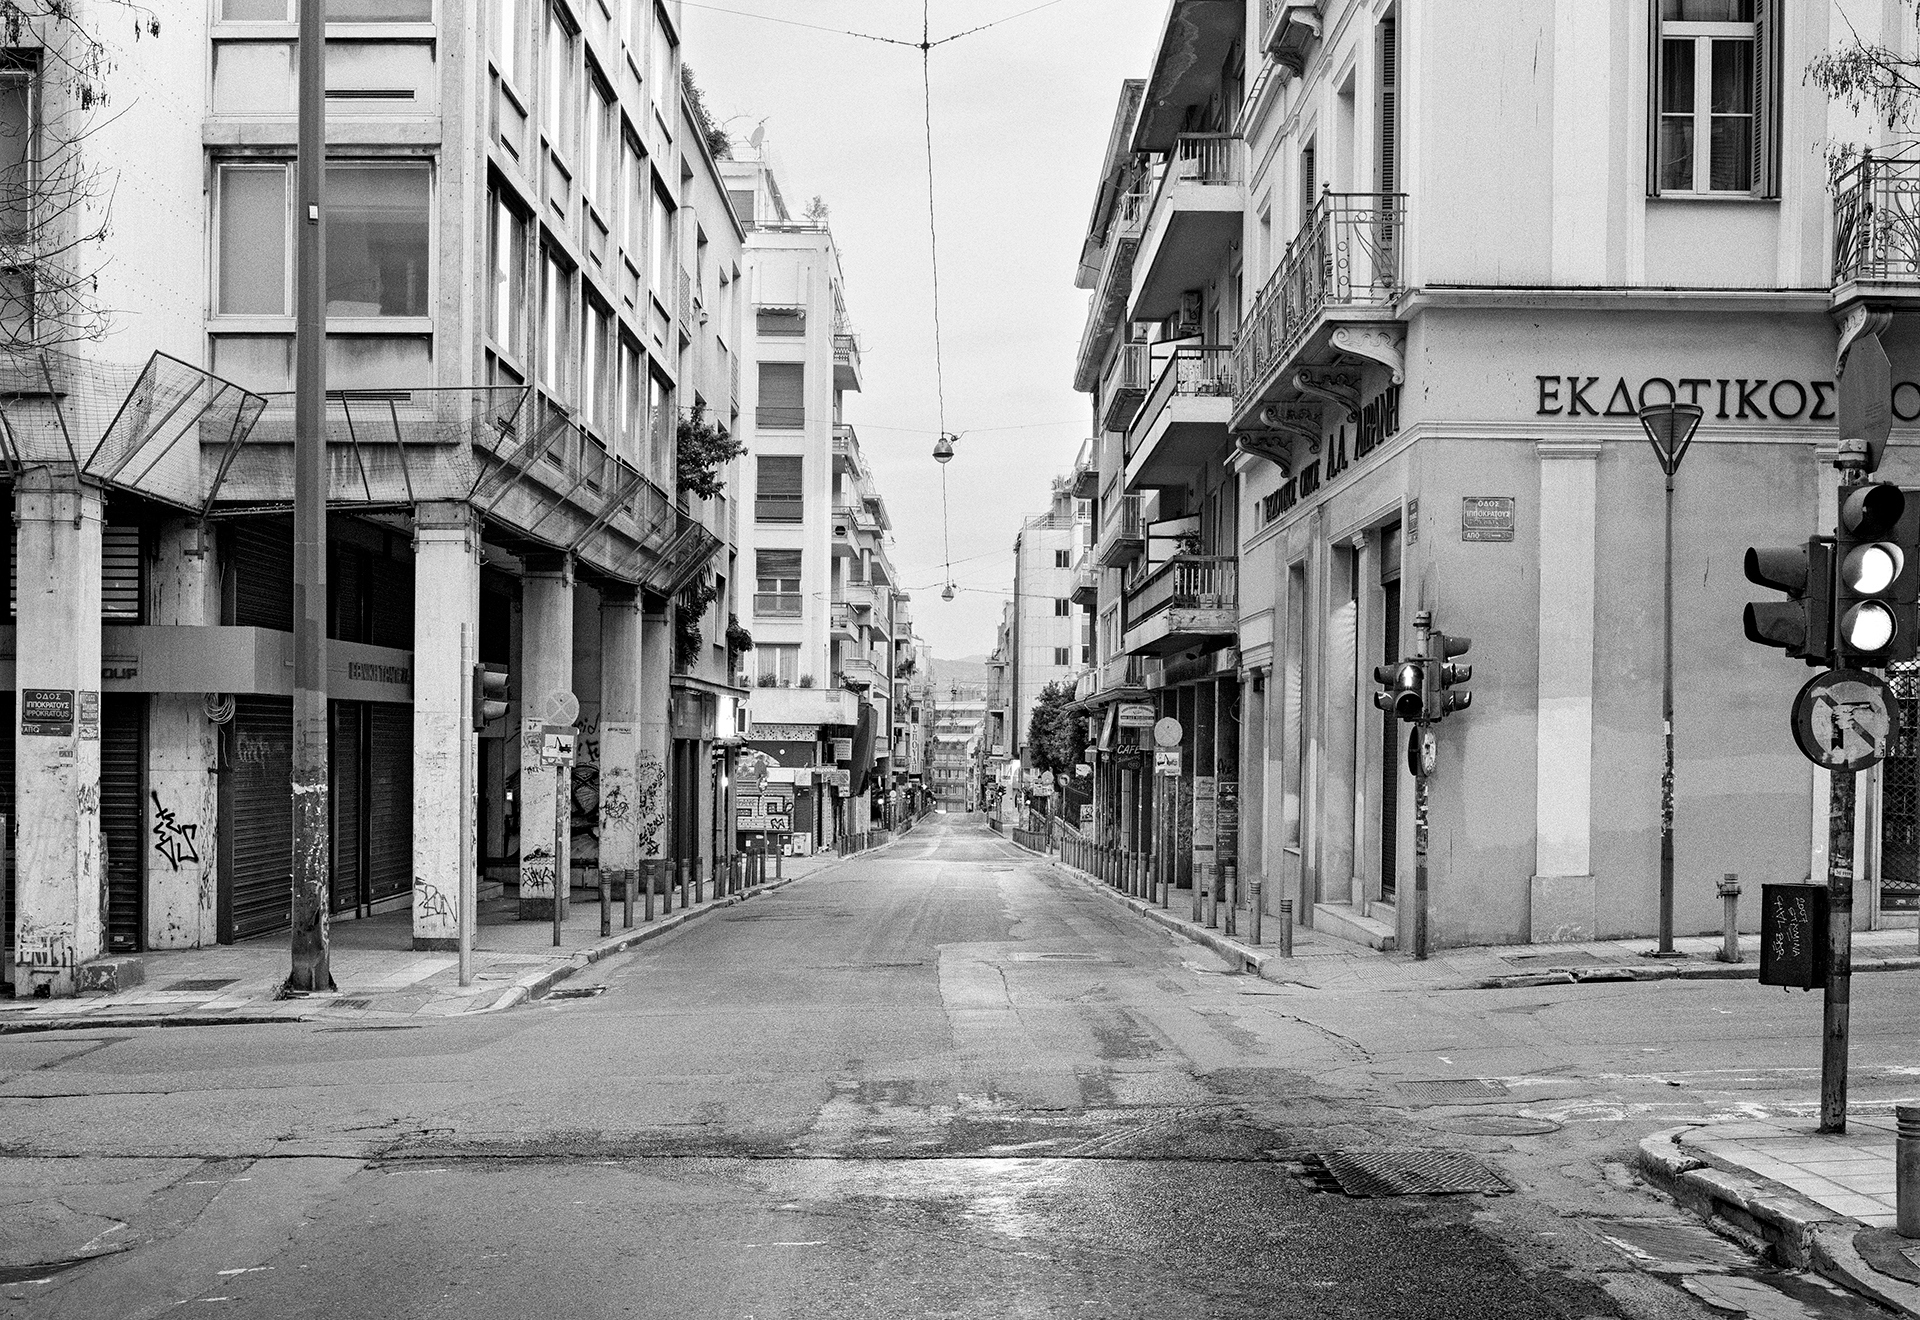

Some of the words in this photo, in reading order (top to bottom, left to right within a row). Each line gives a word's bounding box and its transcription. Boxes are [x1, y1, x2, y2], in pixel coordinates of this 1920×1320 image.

[1536, 375, 1836, 420] ΕΚΔΟΤΙΚΟΣ
[26, 701, 70, 709] ΙΠΠΟΚΡΑΤΟΥΣ
[1117, 744, 1141, 755] CAFE
